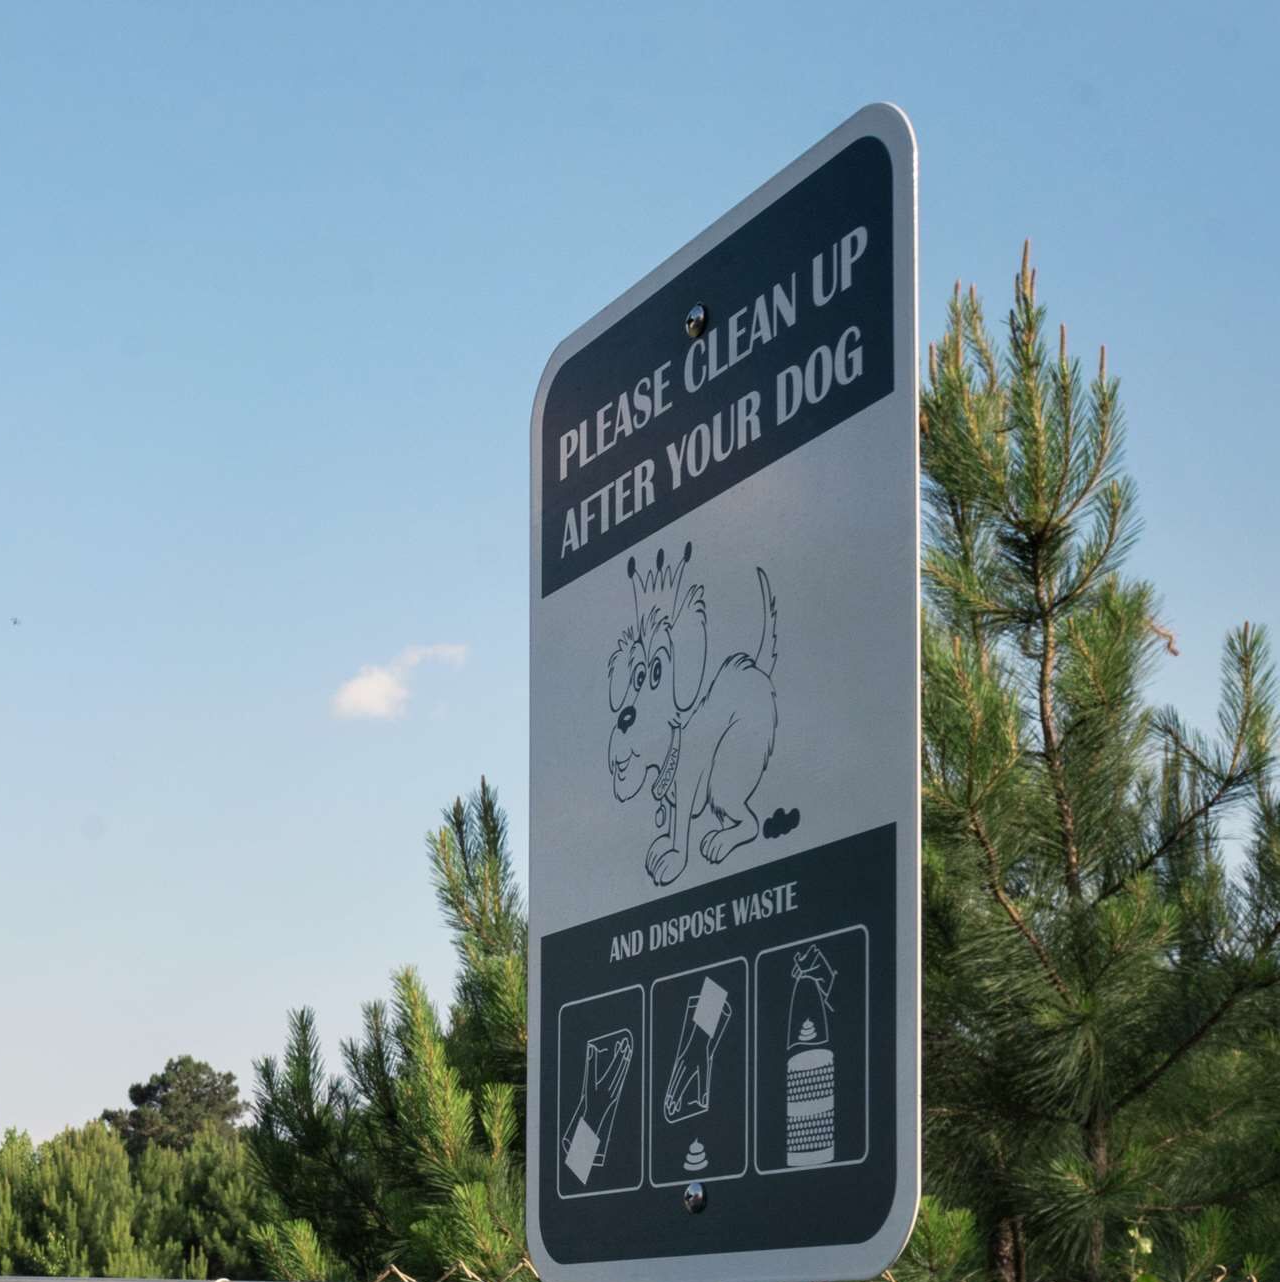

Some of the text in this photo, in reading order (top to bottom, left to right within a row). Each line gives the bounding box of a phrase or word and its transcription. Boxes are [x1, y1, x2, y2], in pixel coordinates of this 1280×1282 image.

[559, 225, 868, 482] PLEASE CLEAN UP
[561, 325, 864, 559] AFTER YOUR DOG
[609, 880, 799, 964] AND DISPOSE WASTE
